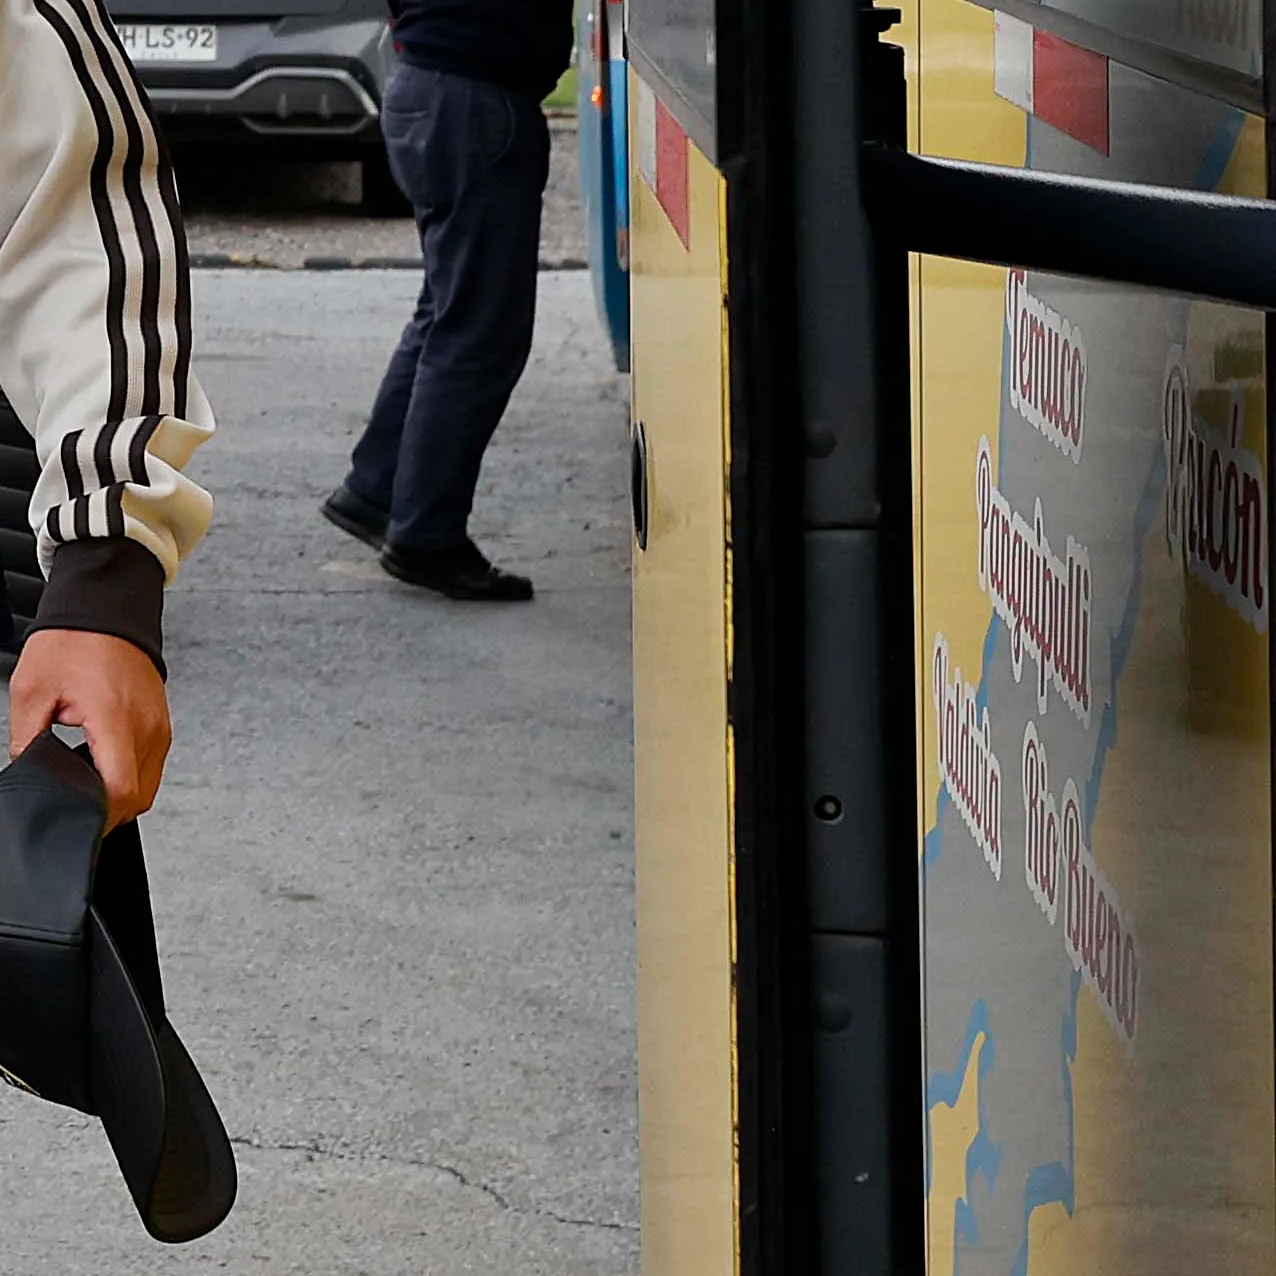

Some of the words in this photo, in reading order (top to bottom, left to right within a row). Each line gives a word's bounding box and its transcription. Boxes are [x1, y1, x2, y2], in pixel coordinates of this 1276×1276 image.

[1006, 267, 1084, 449] Temuco
[976, 450, 1089, 710] Panguipulli
[1162, 364, 1263, 612] Pucón
[934, 645, 1000, 863] Valdivia
[1063, 797, 1138, 1040] Bueno
